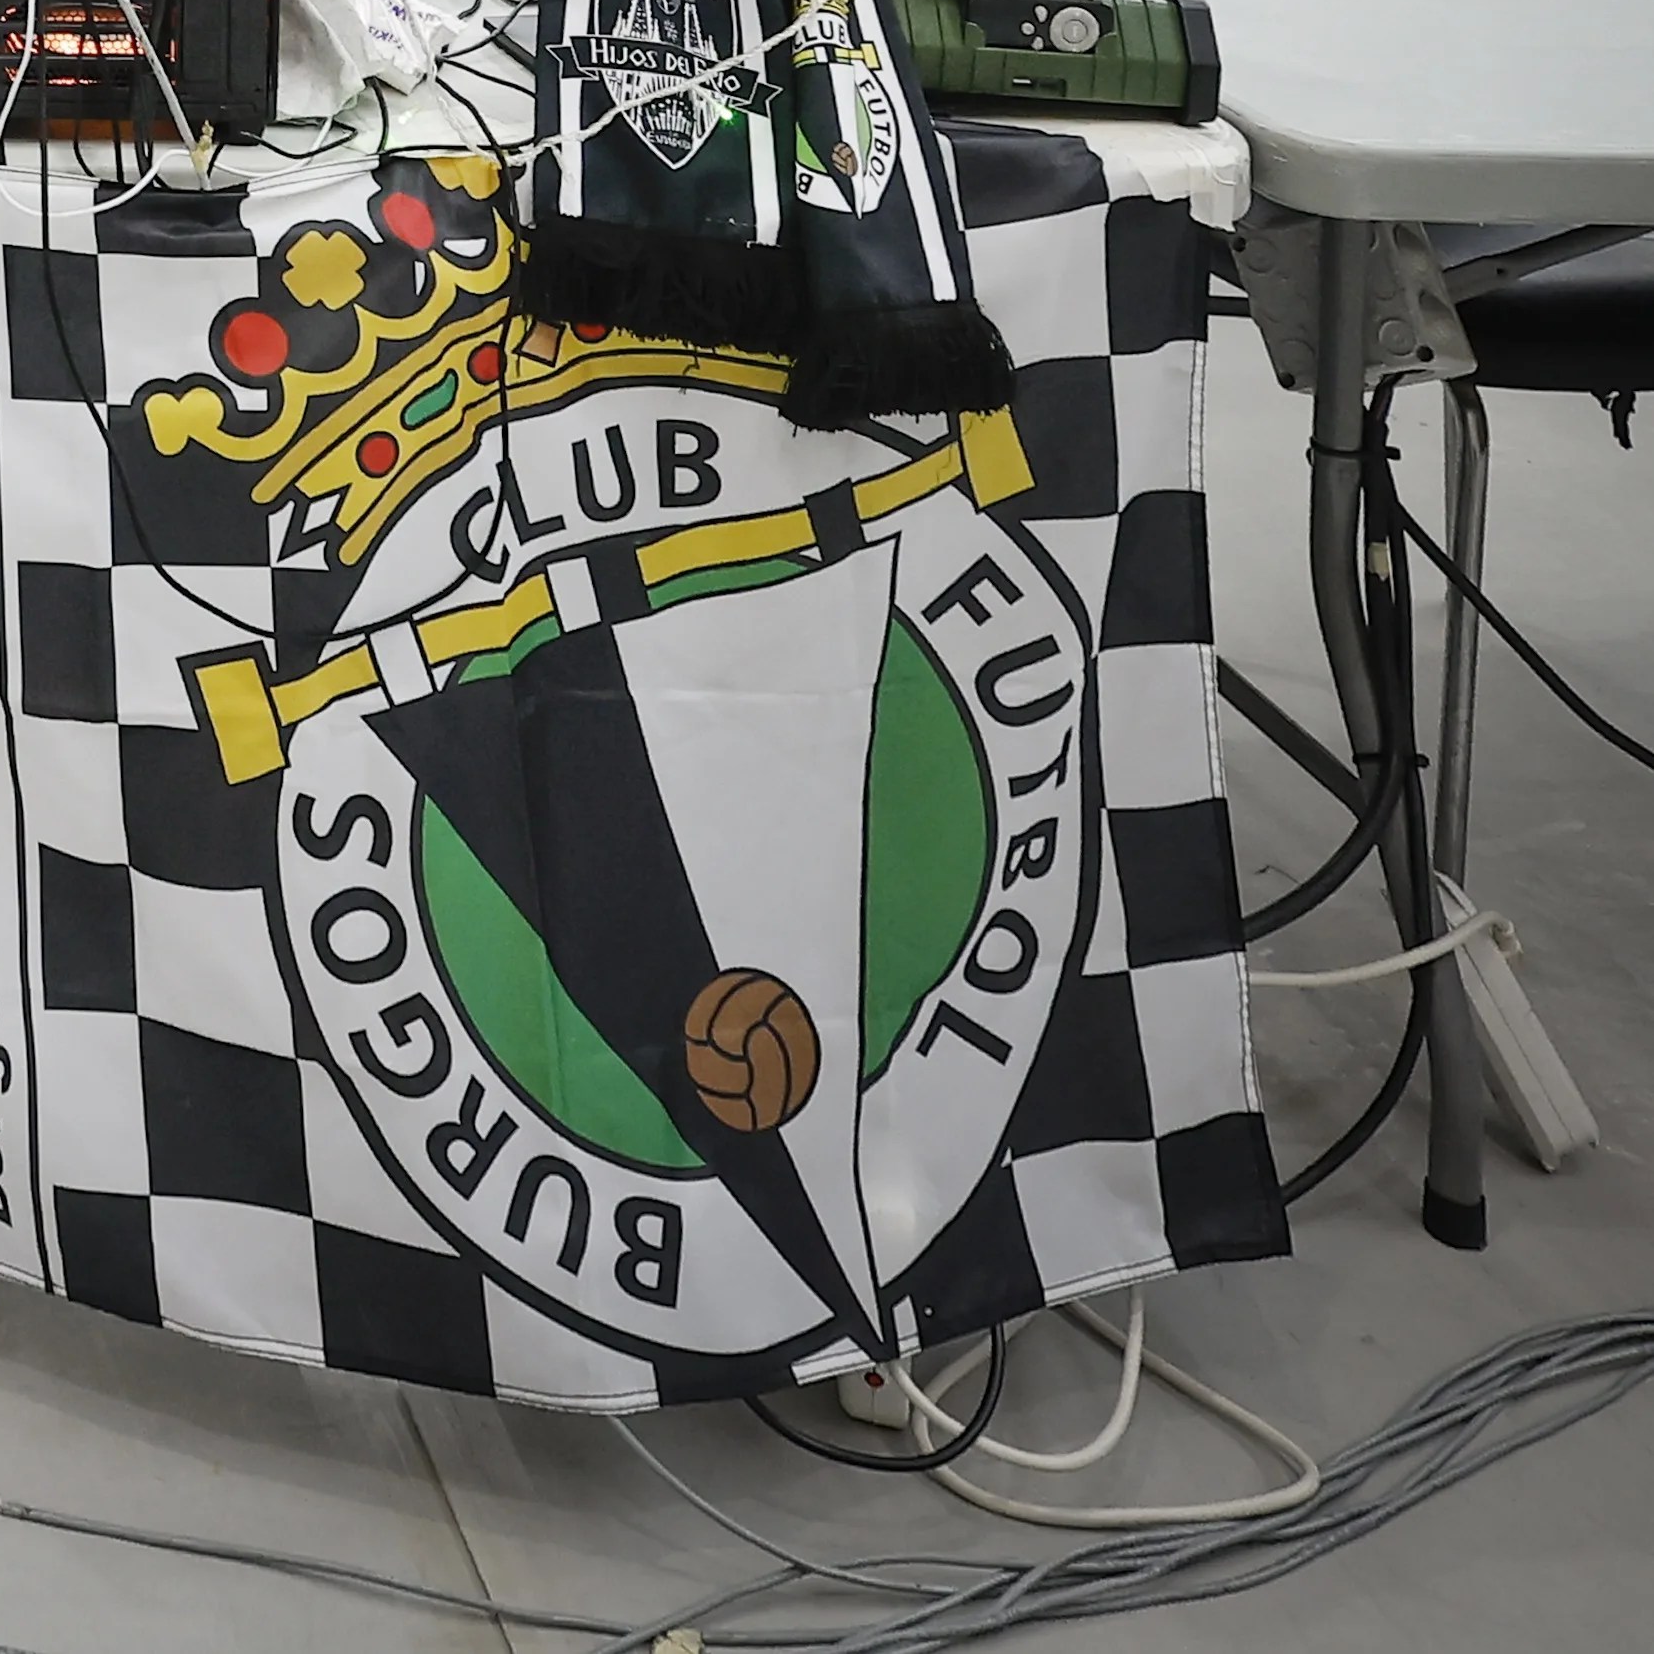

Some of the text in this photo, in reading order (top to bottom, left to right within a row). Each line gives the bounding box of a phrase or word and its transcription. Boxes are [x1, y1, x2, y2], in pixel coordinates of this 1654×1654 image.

[591, 38, 657, 69] HIJOS
[665, 52, 691, 75] DEL
[451, 418, 722, 585] CLUB
[916, 552, 1076, 1066] FUTBOL
[292, 793, 687, 1308] BURGOS
